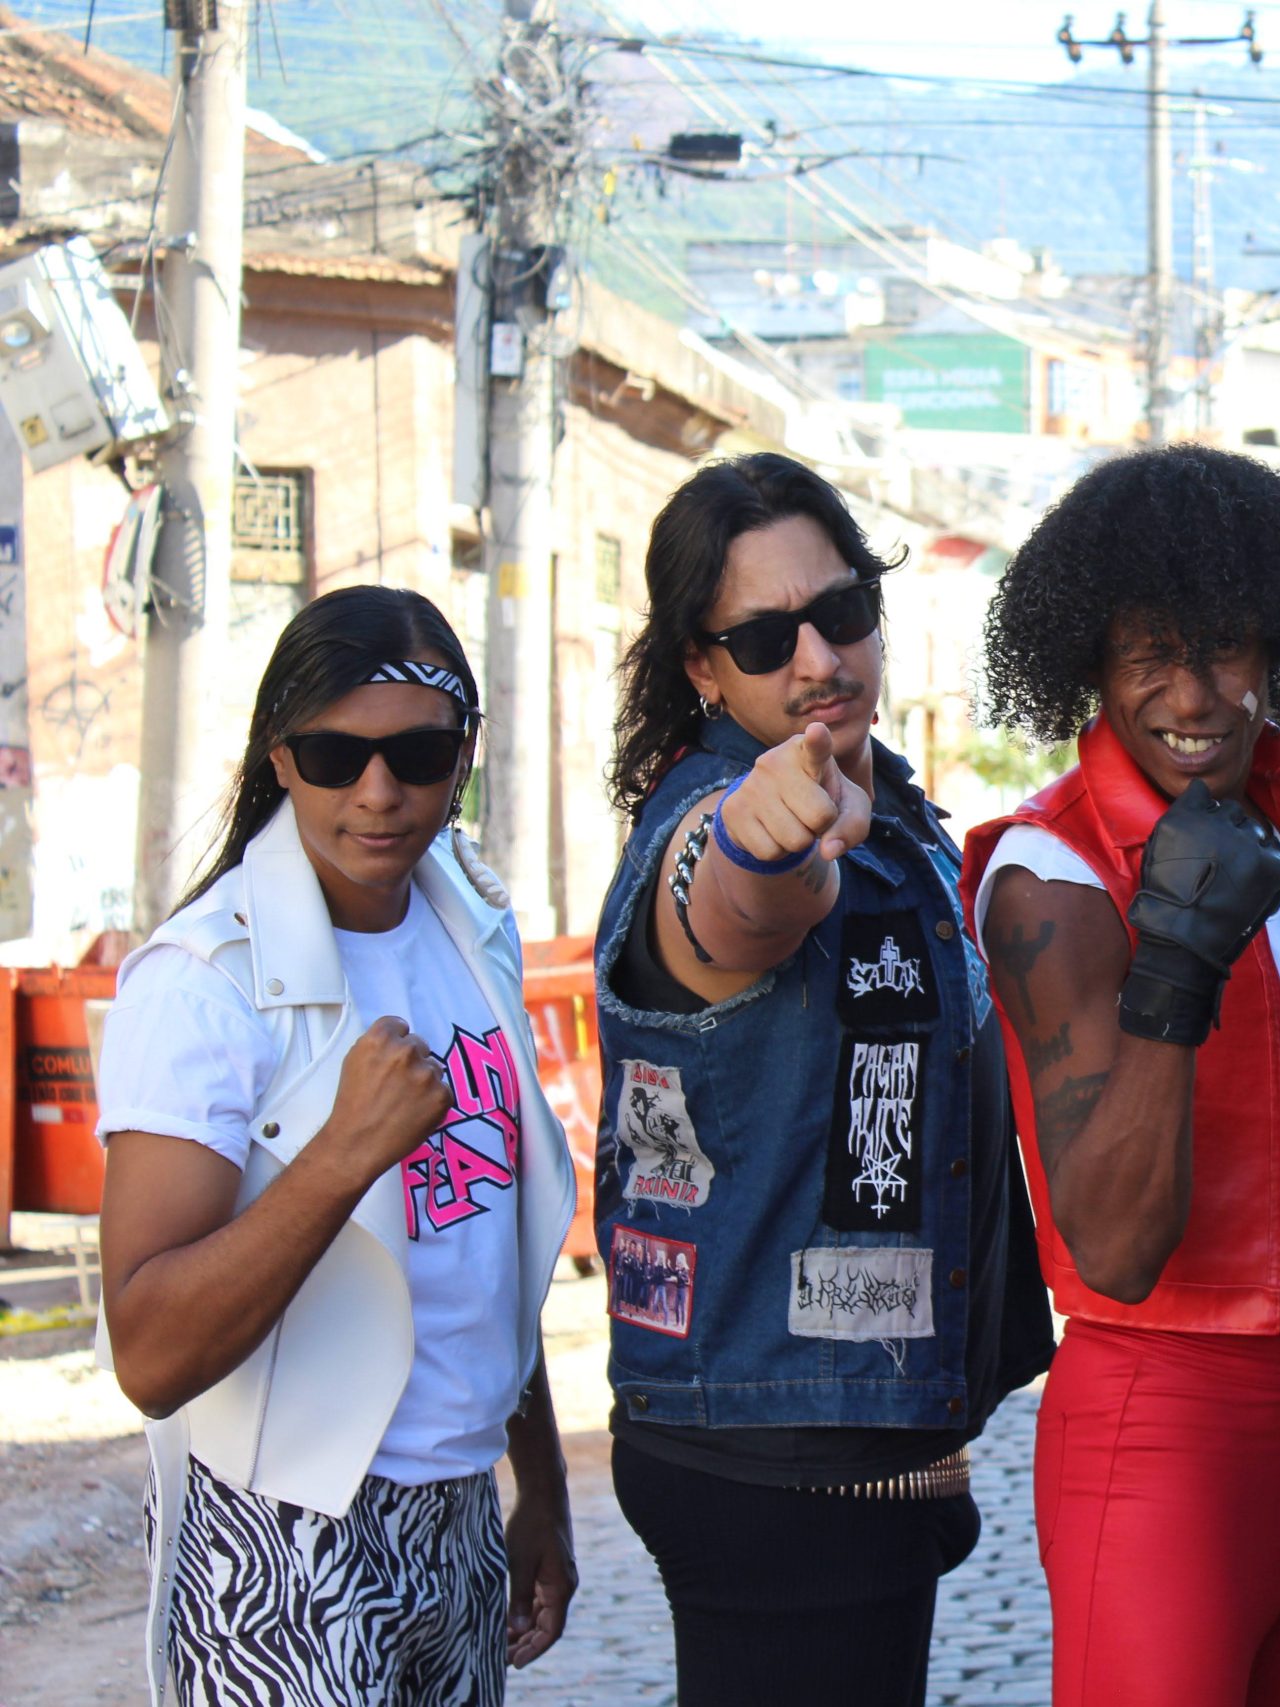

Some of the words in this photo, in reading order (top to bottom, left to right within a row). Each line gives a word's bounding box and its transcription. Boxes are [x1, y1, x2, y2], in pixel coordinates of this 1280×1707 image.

[846, 936, 925, 998] SATAN
[32, 1054, 92, 1074] COMLU
[851, 1043, 919, 1100] PAGAN
